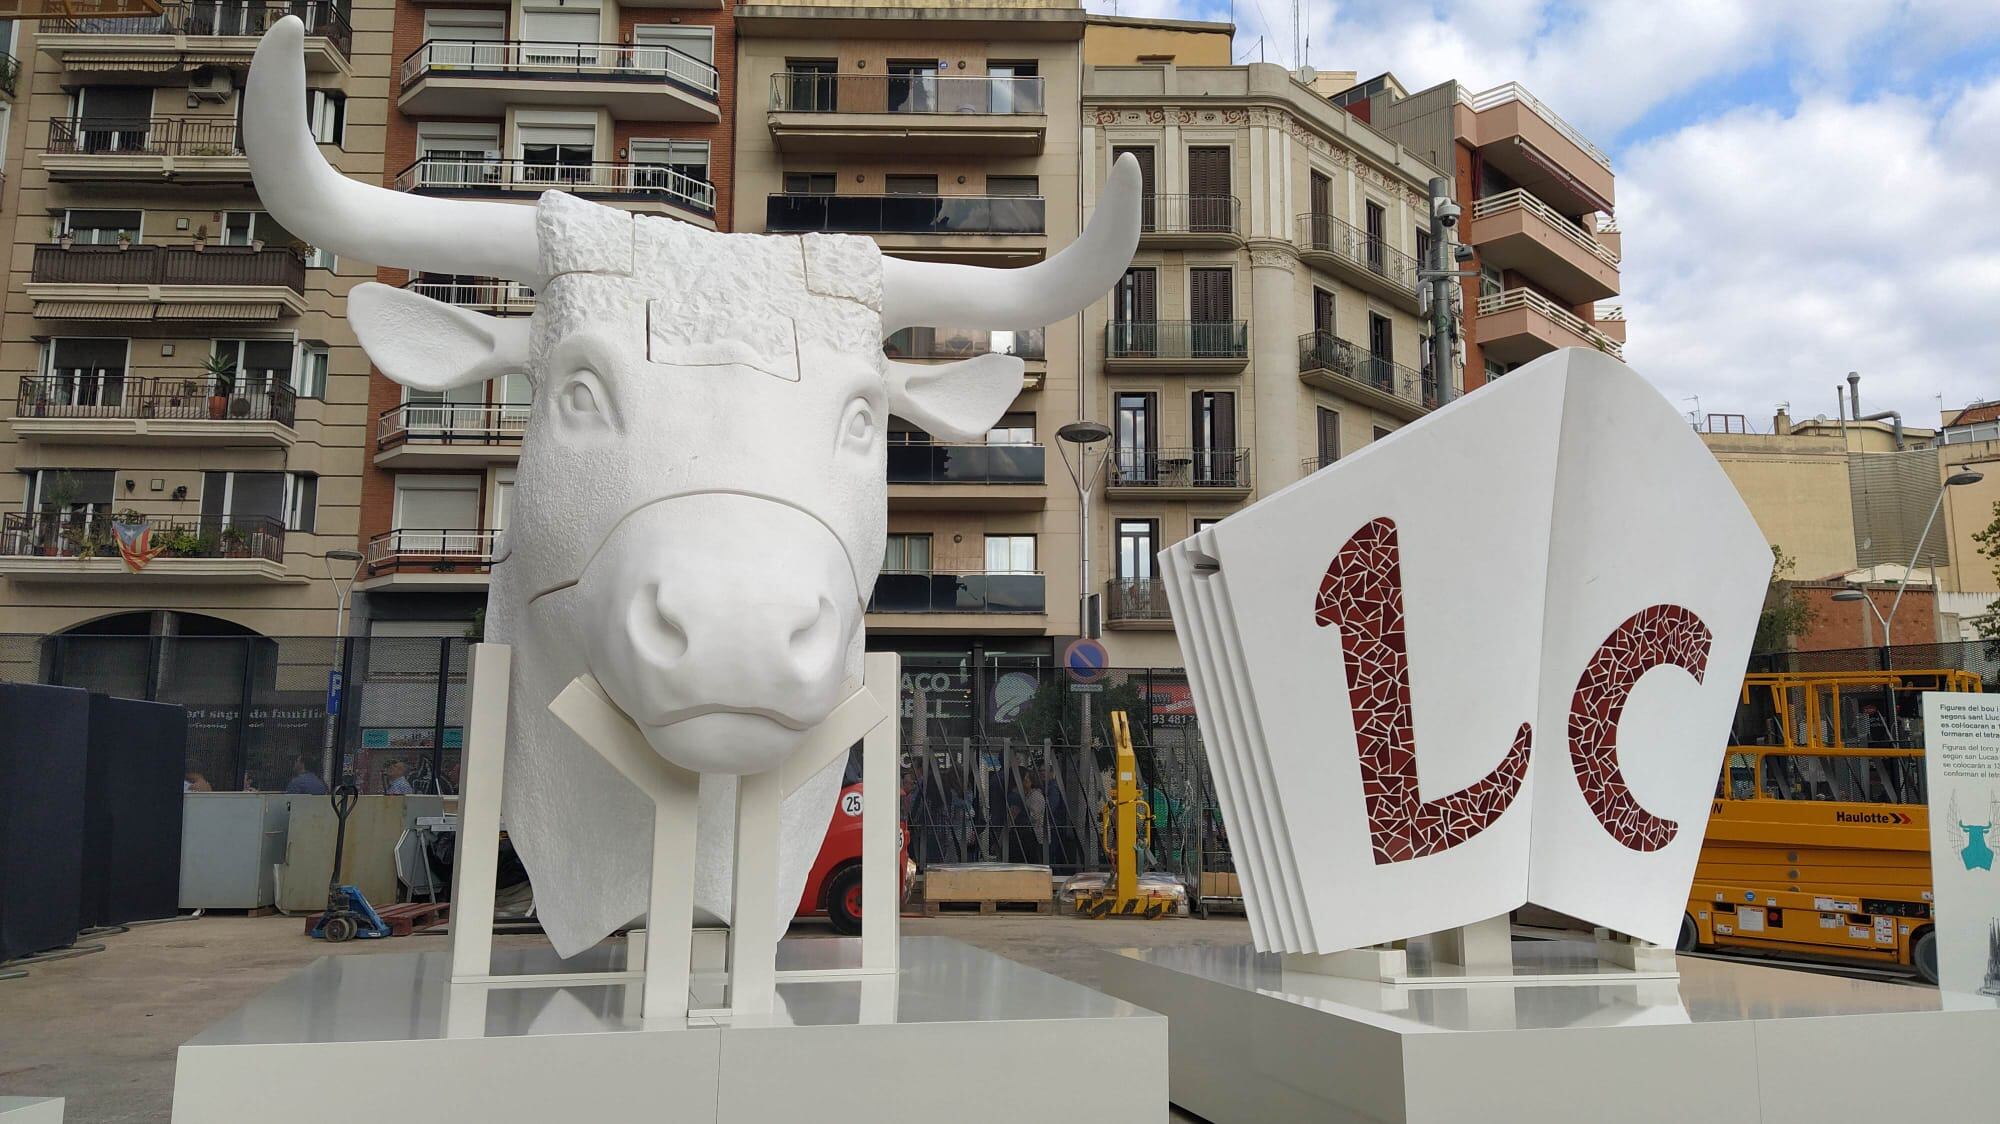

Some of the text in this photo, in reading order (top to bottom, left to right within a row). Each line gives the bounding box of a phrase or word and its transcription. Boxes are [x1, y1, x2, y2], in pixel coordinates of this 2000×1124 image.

[1940, 704, 1966, 712] Figures
[1942, 744, 1967, 752] Figuras
[846, 796, 861, 812] 25
[1836, 811, 1889, 824] Haulotte
